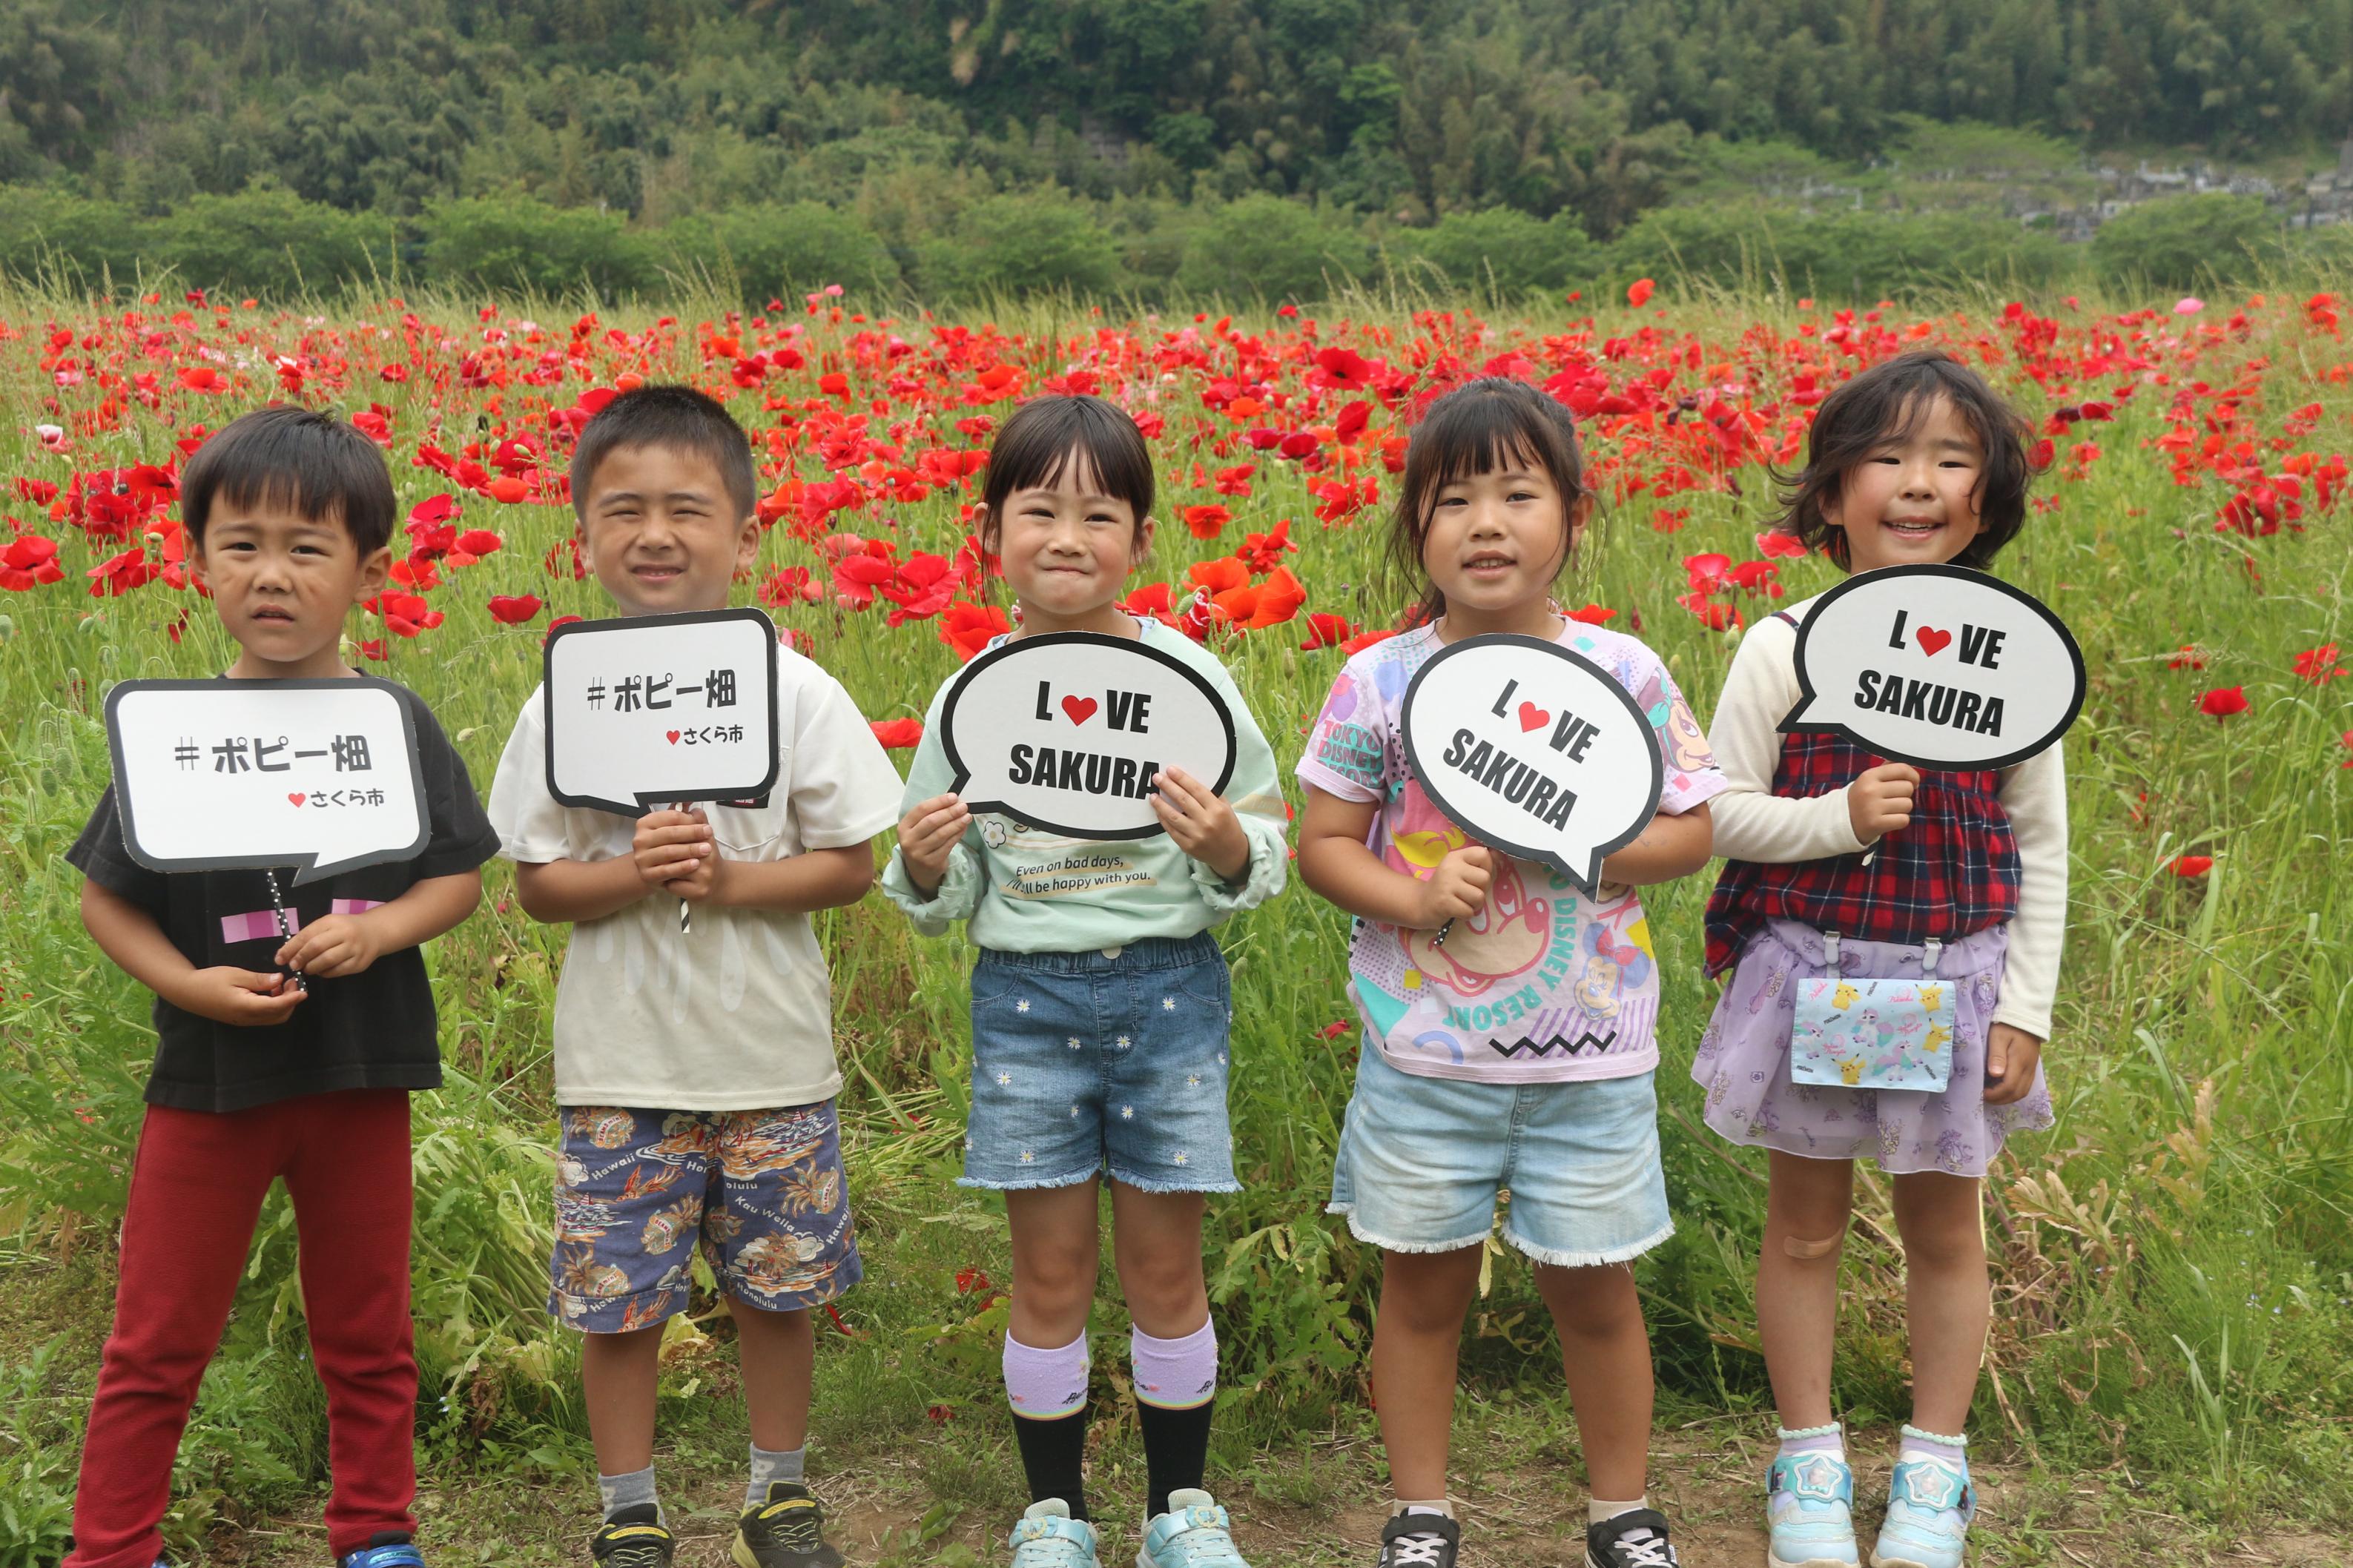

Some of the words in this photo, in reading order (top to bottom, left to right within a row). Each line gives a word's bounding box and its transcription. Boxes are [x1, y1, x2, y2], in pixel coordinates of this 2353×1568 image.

[1854, 669, 2004, 738] SAKURA
[683, 724, 744, 745] さくら市
[1324, 720, 1379, 752] TOKYO
[1317, 740, 1383, 770] DISNEY
[1009, 744, 1161, 800] SAKURA
[1443, 728, 1578, 832] SAKURA
[310, 788, 385, 808] さくら市
[1016, 865, 1043, 877] Even
[1046, 861, 1061, 873] on
[1064, 856, 1089, 870] bad
[1091, 855, 1123, 870] days,
[1035, 881, 1050, 893] be
[1052, 878, 1092, 893] happy
[1094, 873, 1122, 886] with
[1124, 871, 1151, 886] you.
[1537, 897, 1577, 992] DISNEY
[1442, 984, 1542, 1032] RESORT
[591, 1153, 636, 1180] Hawaii
[735, 1195, 758, 1214] Kau
[762, 1208, 795, 1232] Wella
[736, 1282, 778, 1310] Honolulu
